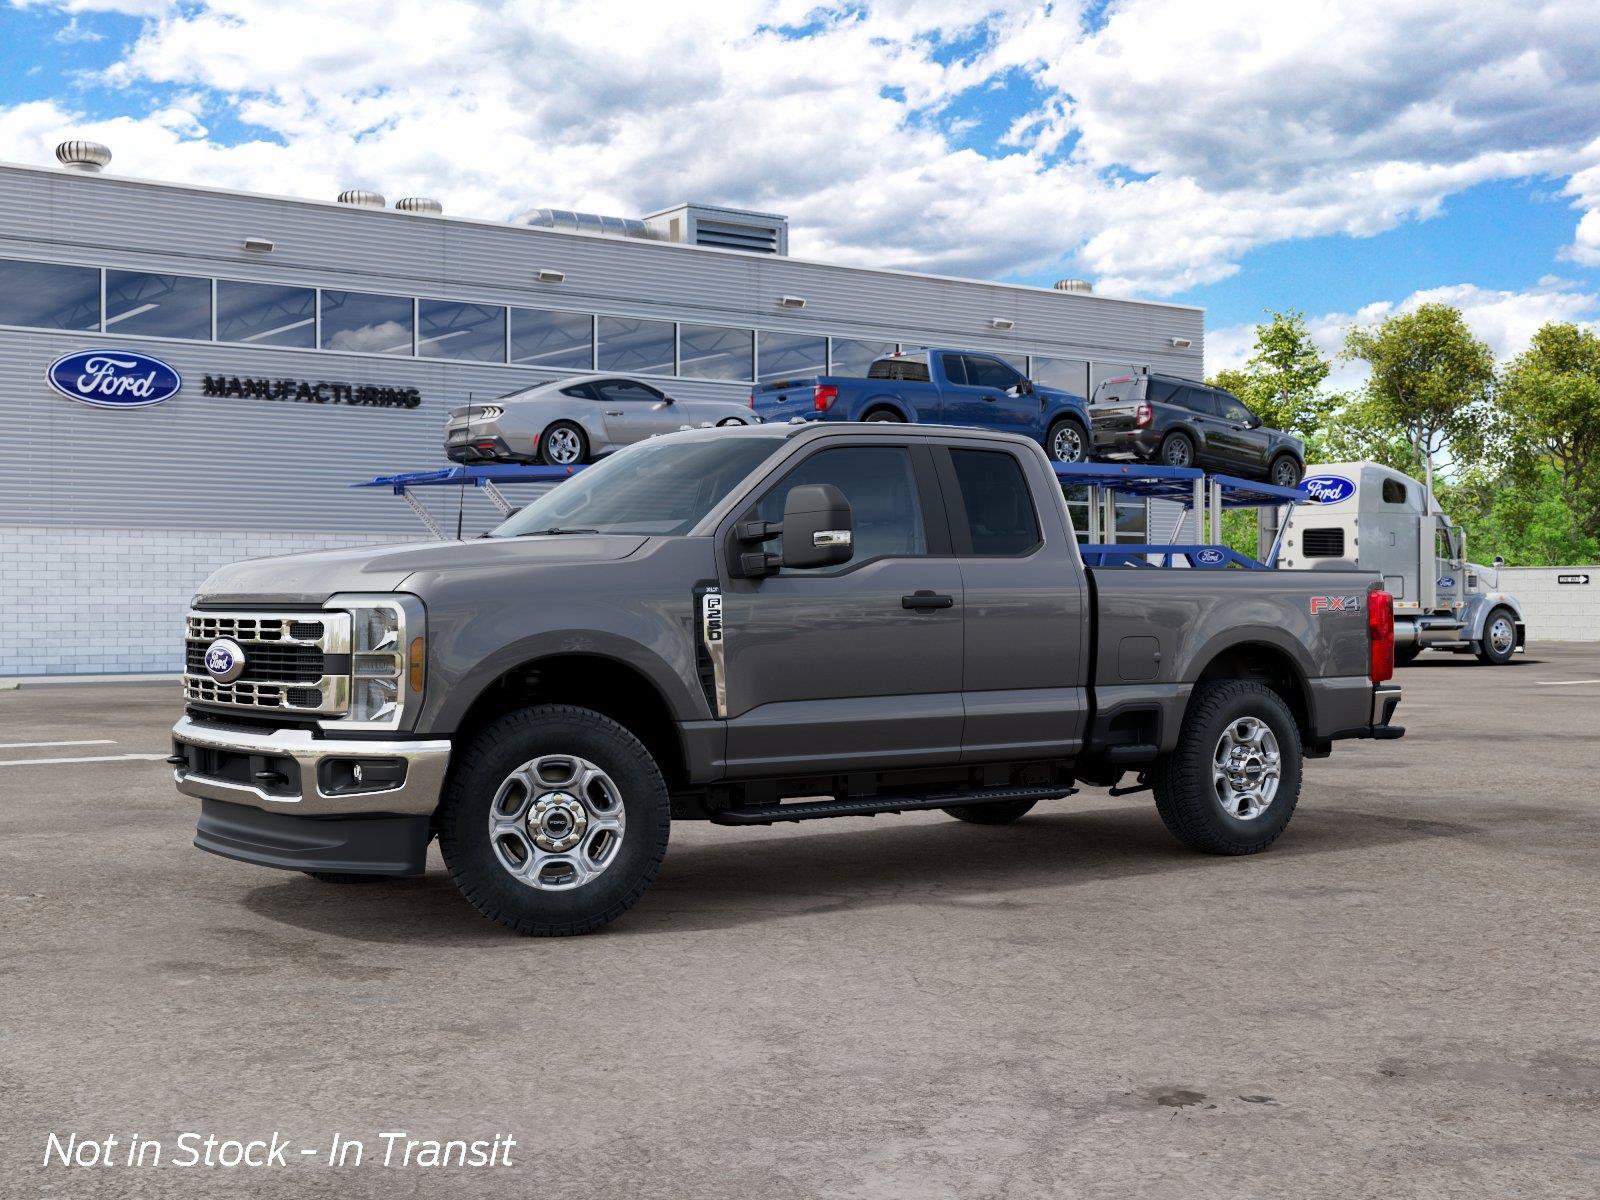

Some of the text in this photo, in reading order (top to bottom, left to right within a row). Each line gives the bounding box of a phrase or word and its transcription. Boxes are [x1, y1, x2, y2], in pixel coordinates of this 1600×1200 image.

[77, 357, 157, 398] Ford
[202, 374, 421, 409] MANUFACTURING
[1306, 479, 1343, 500] Ford
[1201, 550, 1220, 562] Ford
[1439, 576, 1453, 587] Ford
[1309, 596, 1361, 616] FX4
[210, 650, 228, 669] Ford
